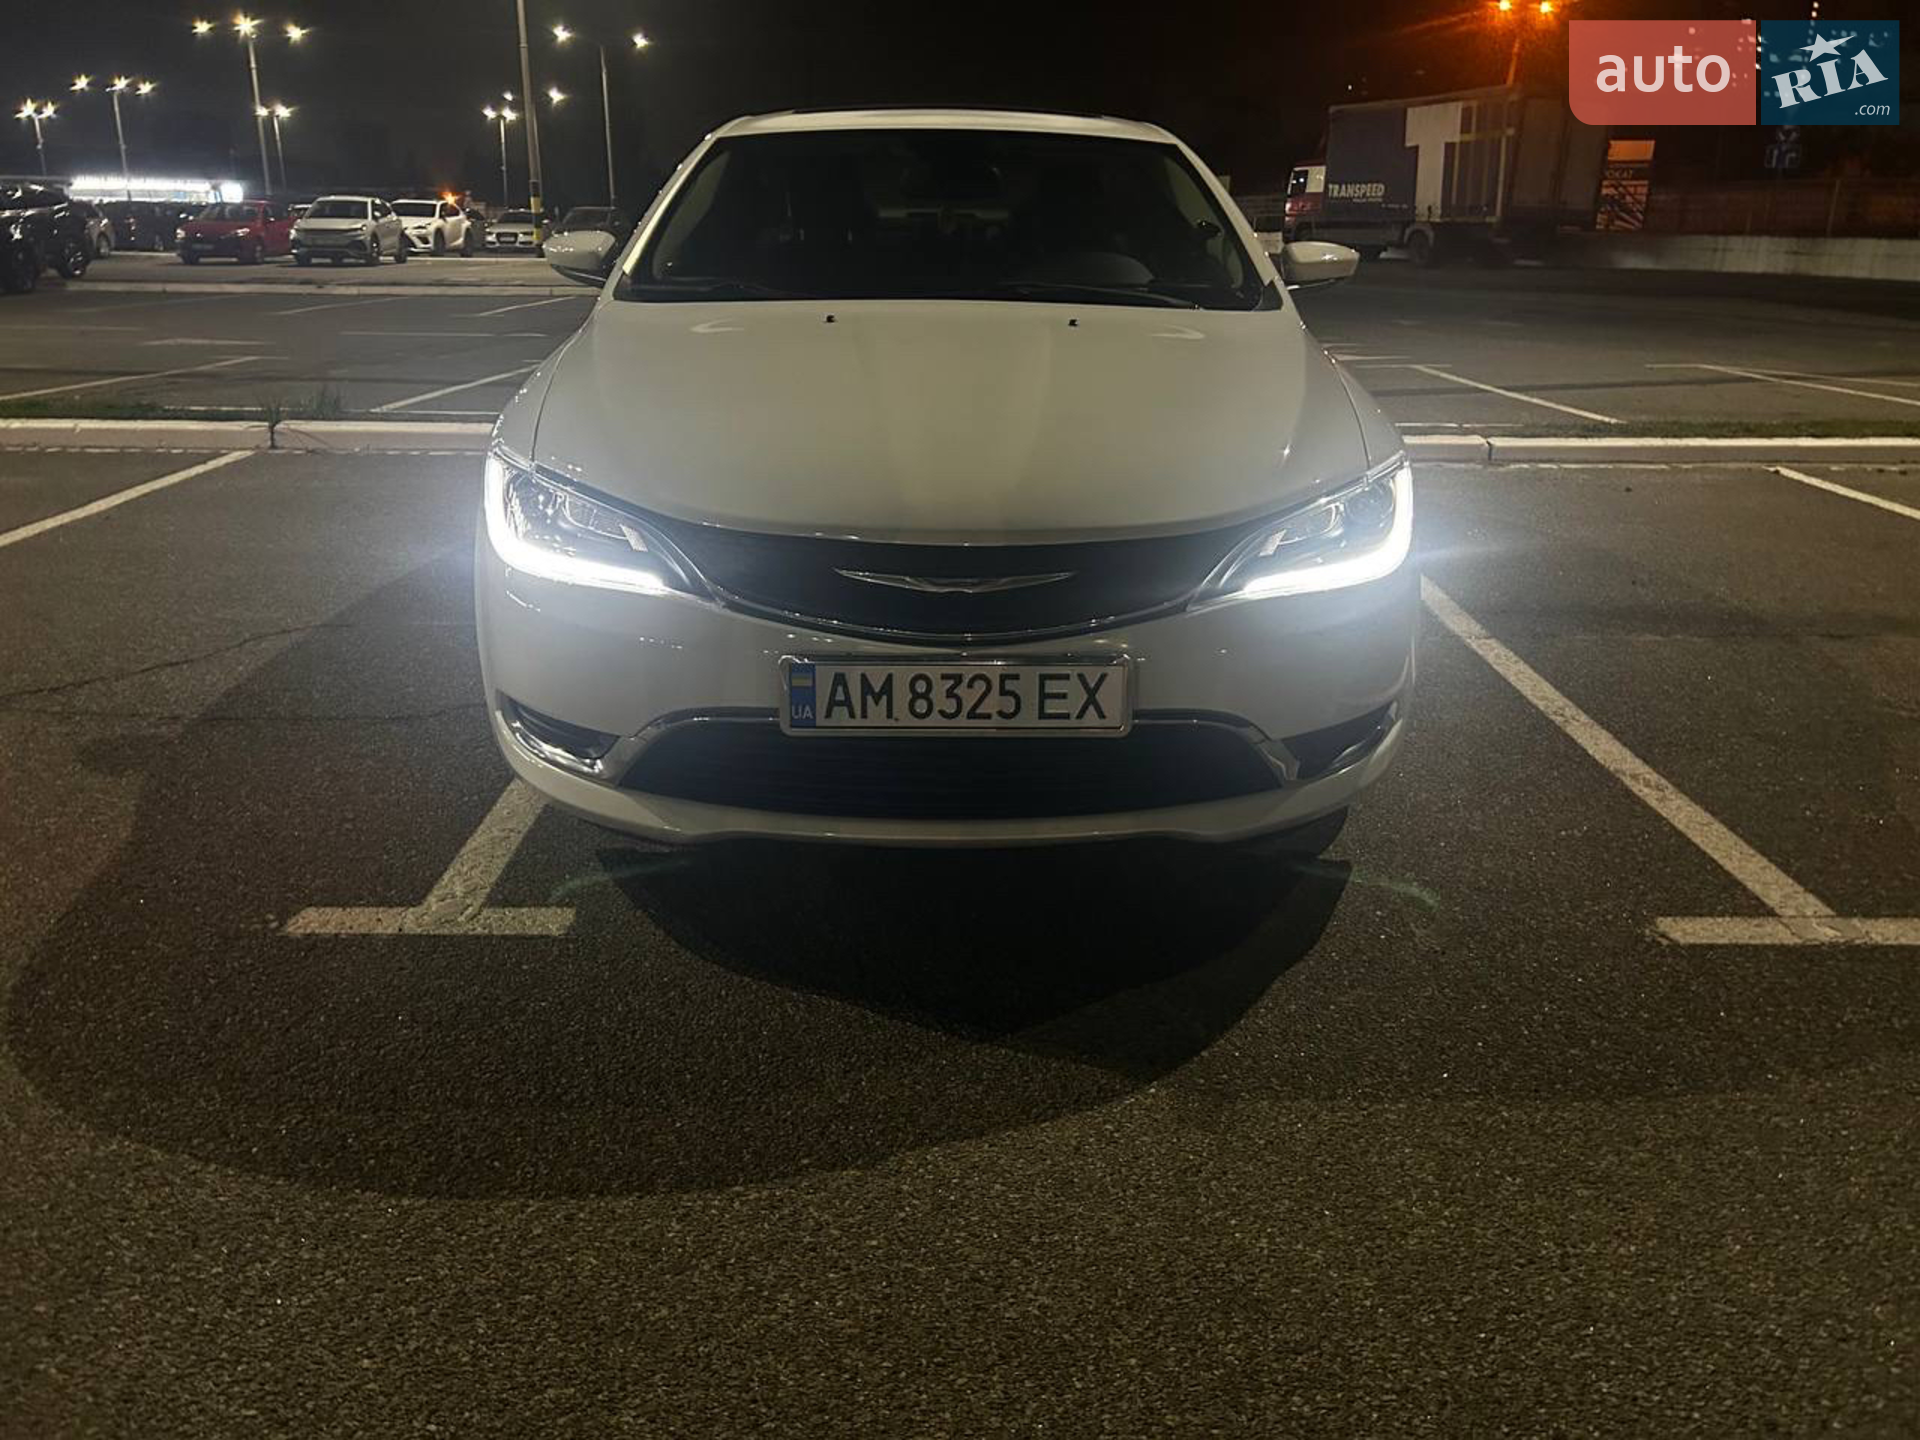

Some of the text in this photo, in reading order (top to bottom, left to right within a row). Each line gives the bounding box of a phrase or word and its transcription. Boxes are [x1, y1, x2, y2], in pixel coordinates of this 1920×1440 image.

[1328, 183, 1386, 199] TRANSPEED
[823, 672, 1109, 720] AM 8325 EX
[791, 704, 814, 719] UA
